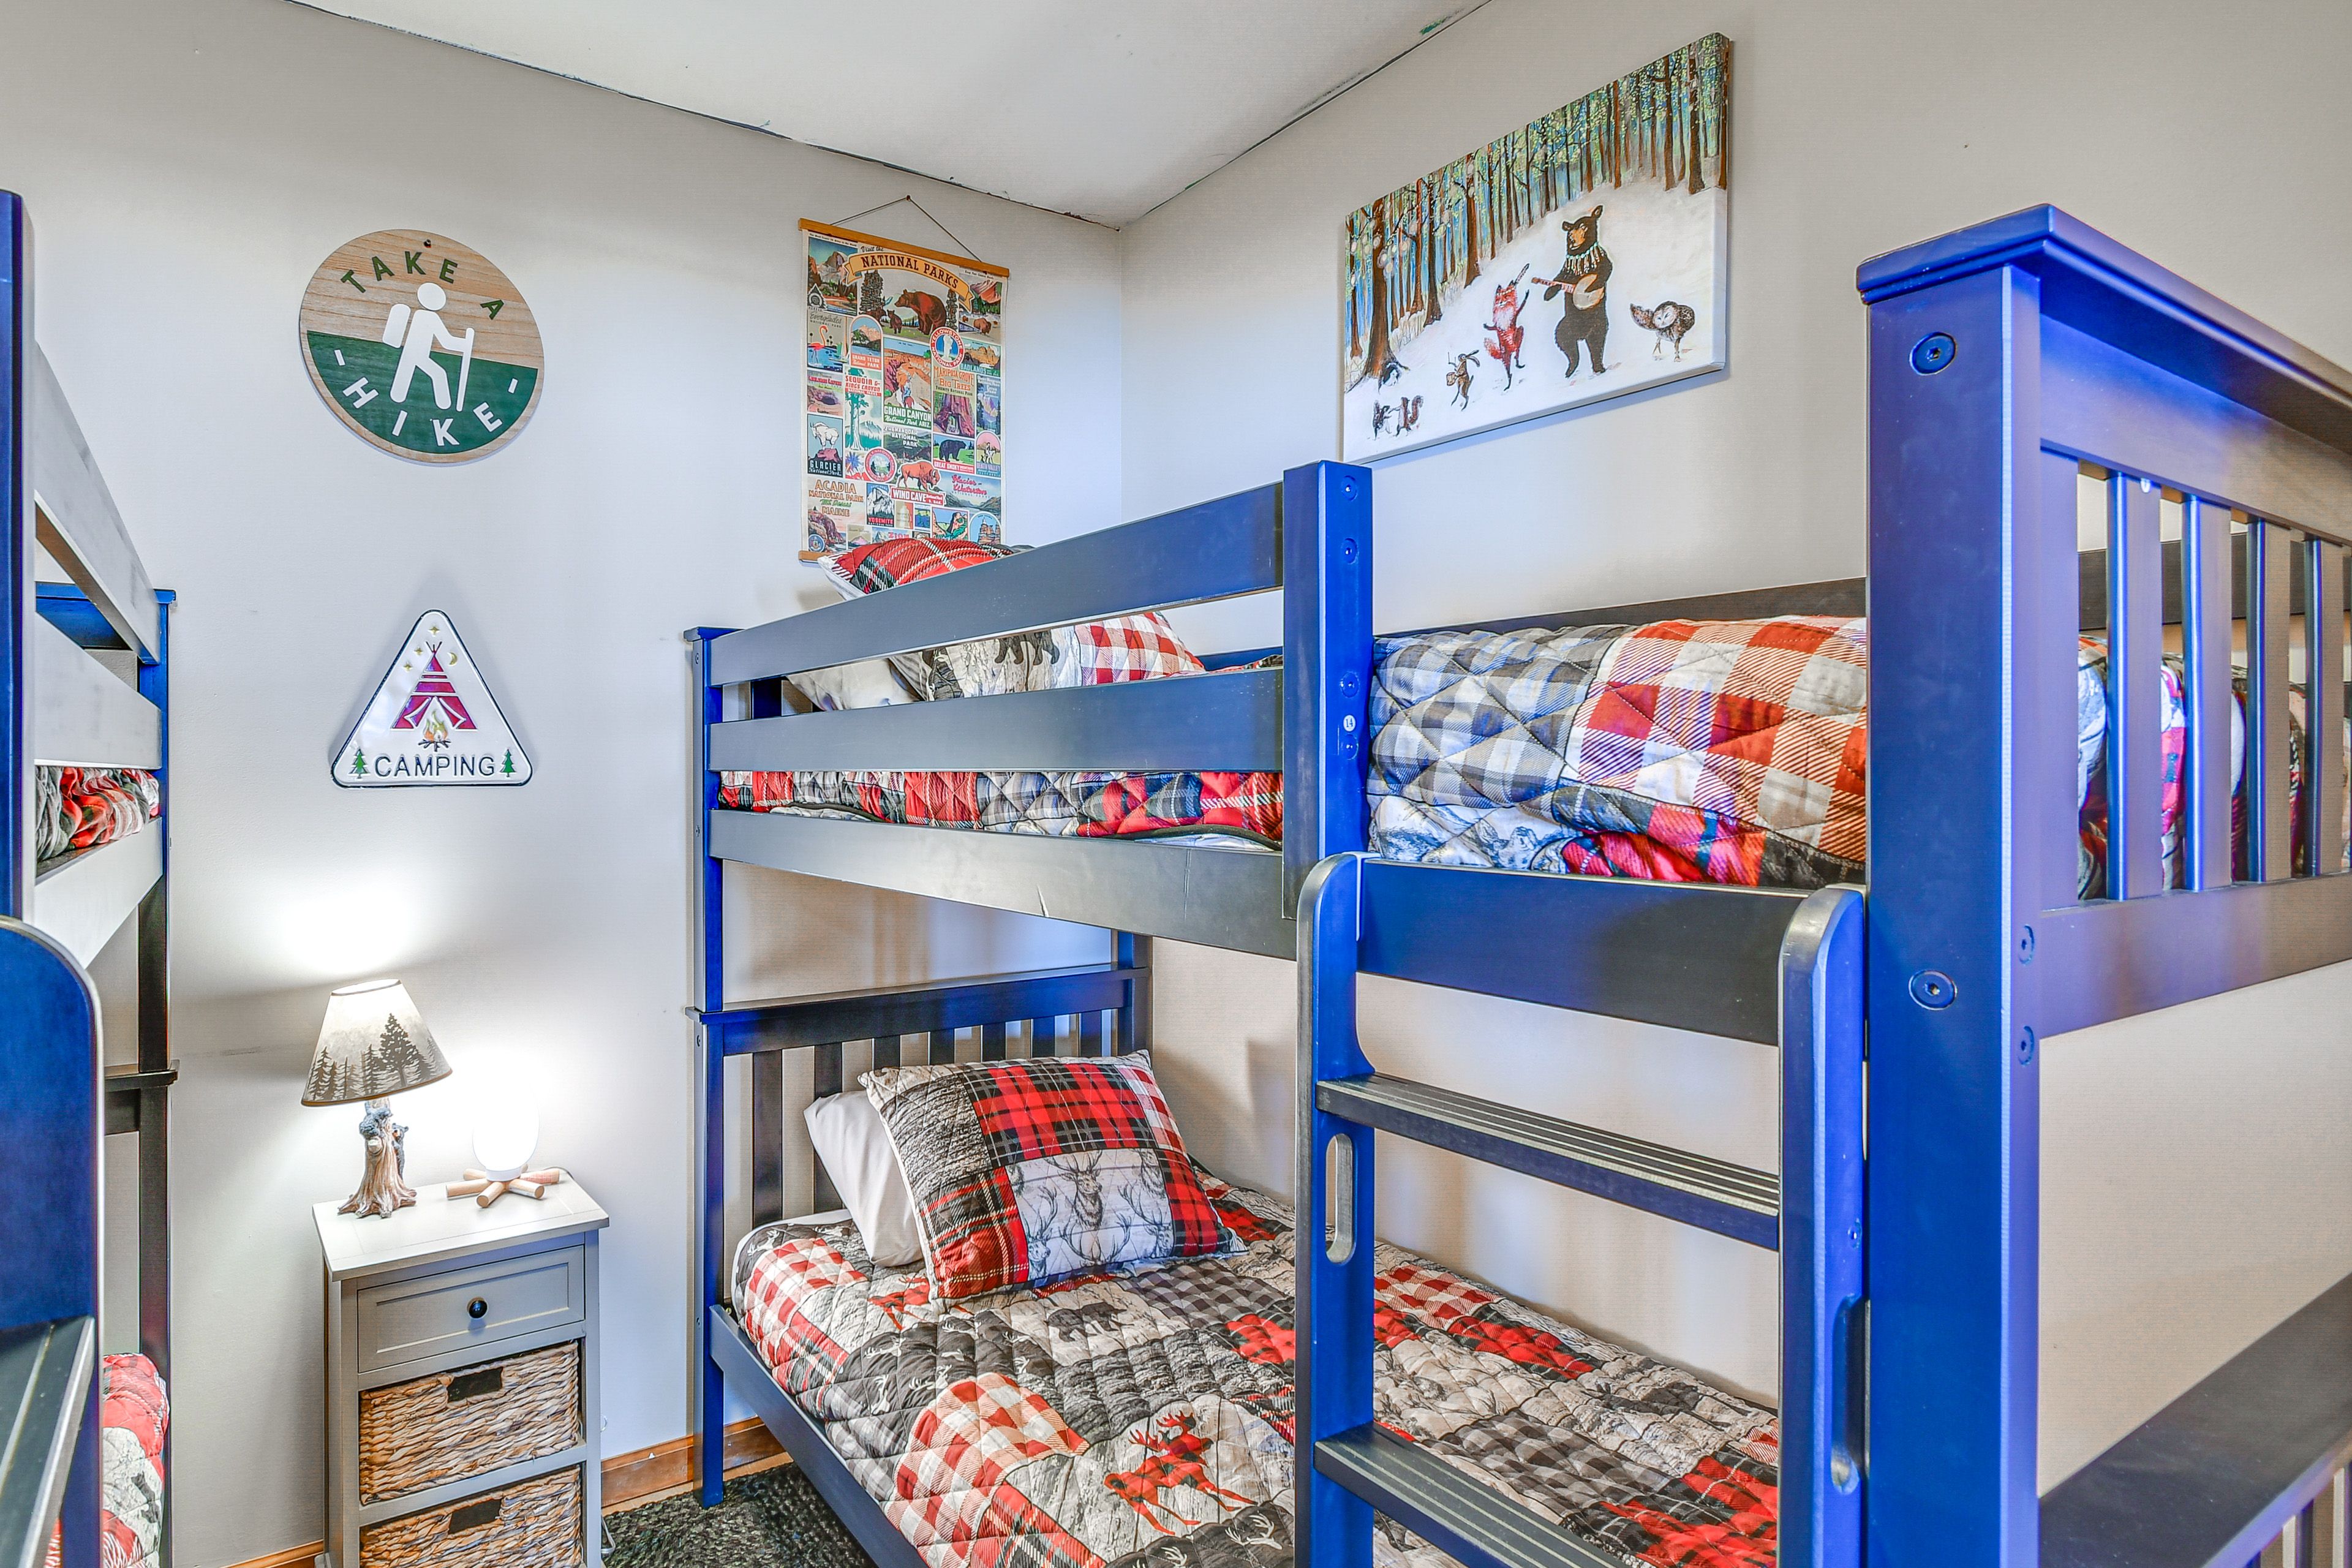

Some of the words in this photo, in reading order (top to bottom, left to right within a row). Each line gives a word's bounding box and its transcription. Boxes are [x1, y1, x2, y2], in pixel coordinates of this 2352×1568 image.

[860, 254, 919, 271] NATIONAL
[924, 263, 959, 289] PARKS
[340, 251, 458, 293] TAKE
[480, 299, 504, 320] A
[932, 329, 963, 349] YELLOWSTONE
[932, 347, 953, 367] NATIONAL
[953, 353, 963, 366] PARK
[933, 366, 959, 379] MARIPOSA
[960, 364, 986, 374] BADLANDS
[845, 375, 872, 385] SEQUOIA
[884, 405, 906, 418] GRAND
[907, 409, 931, 421] CANYON
[884, 415, 907, 424] National
[883, 426, 918, 435] SHENANDOAH
[810, 460, 841, 472] GLACIER
[815, 479, 857, 494] ACADIA
[809, 490, 845, 500] NATIONAL
[845, 494, 864, 502] PARK
[892, 489, 910, 500] WIND
[911, 492, 927, 502] CAVE
[821, 506, 850, 517] MAINE
[1346, 718, 1354, 728] 14
[374, 754, 496, 777] CAMPING
